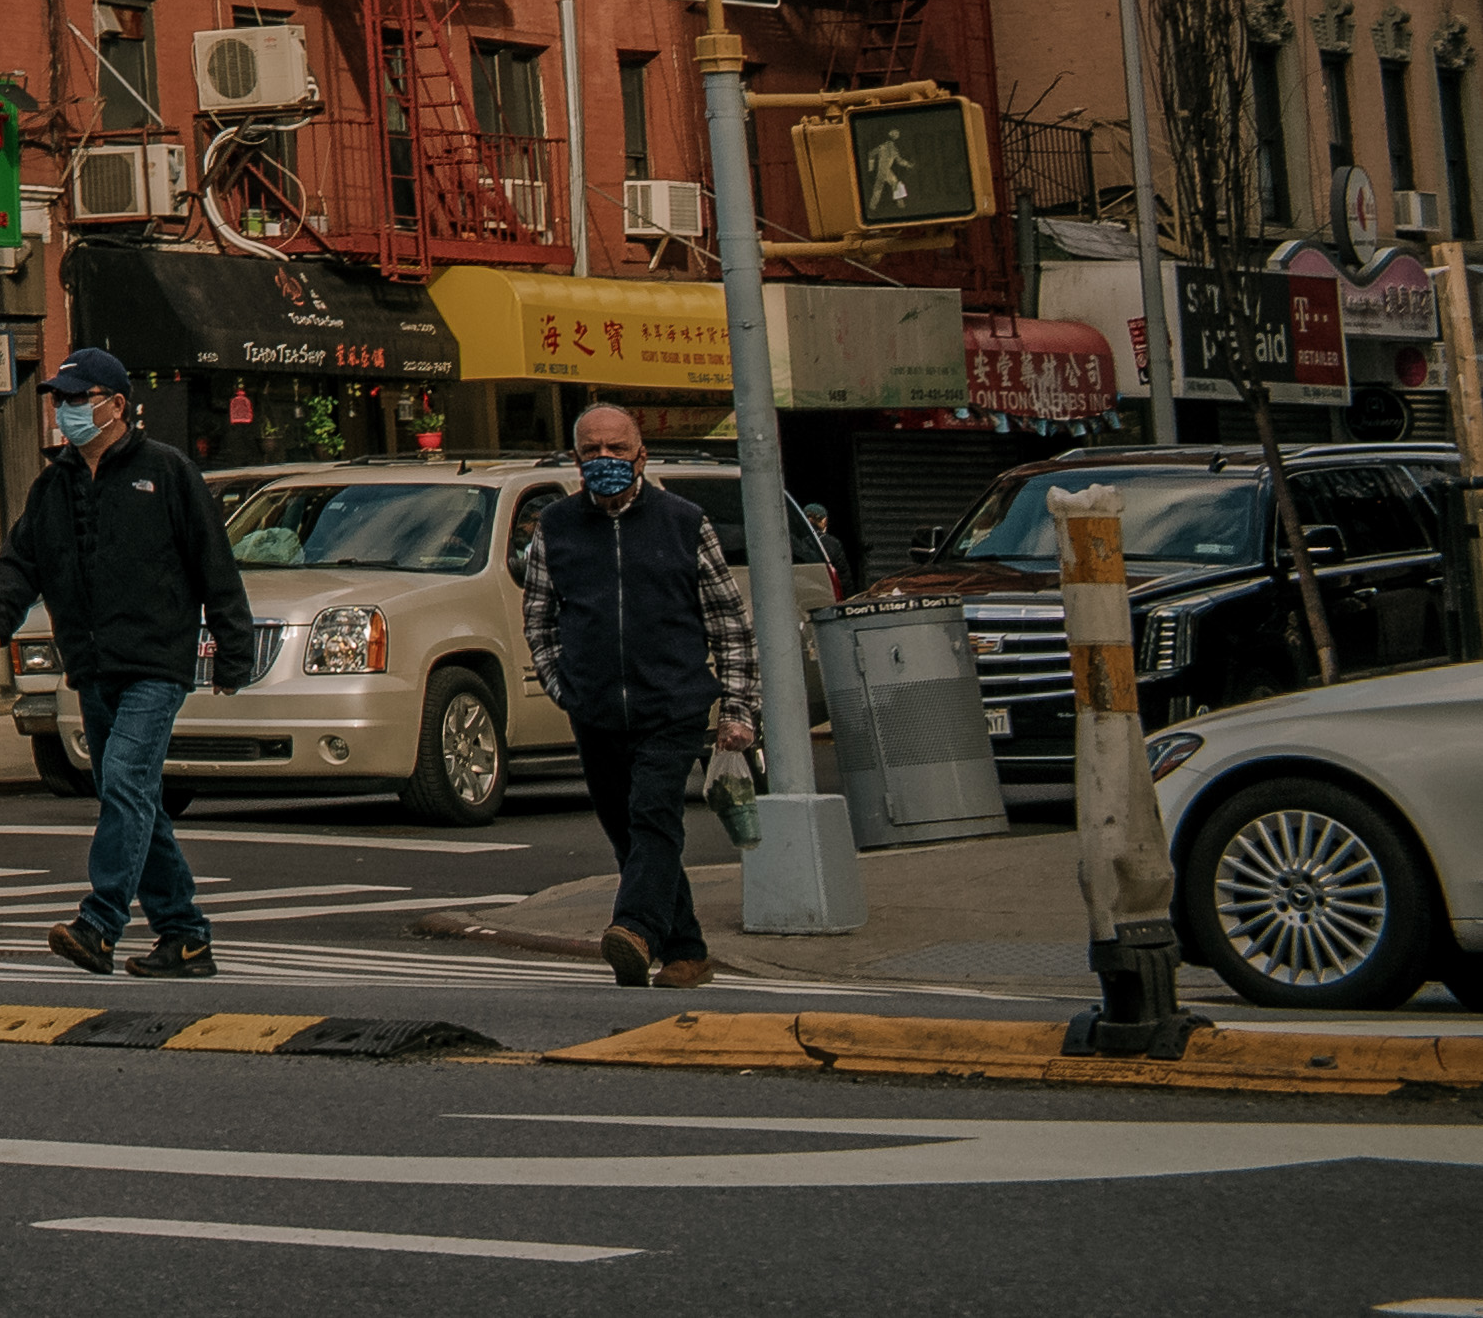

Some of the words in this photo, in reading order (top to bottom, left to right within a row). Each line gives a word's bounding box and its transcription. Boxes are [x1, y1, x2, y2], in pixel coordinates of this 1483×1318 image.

[1298, 350, 1340, 367] RETAILER
[1089, 392, 1112, 410] INC
[844, 603, 876, 616] Don't
[921, 597, 946, 608] Don't
